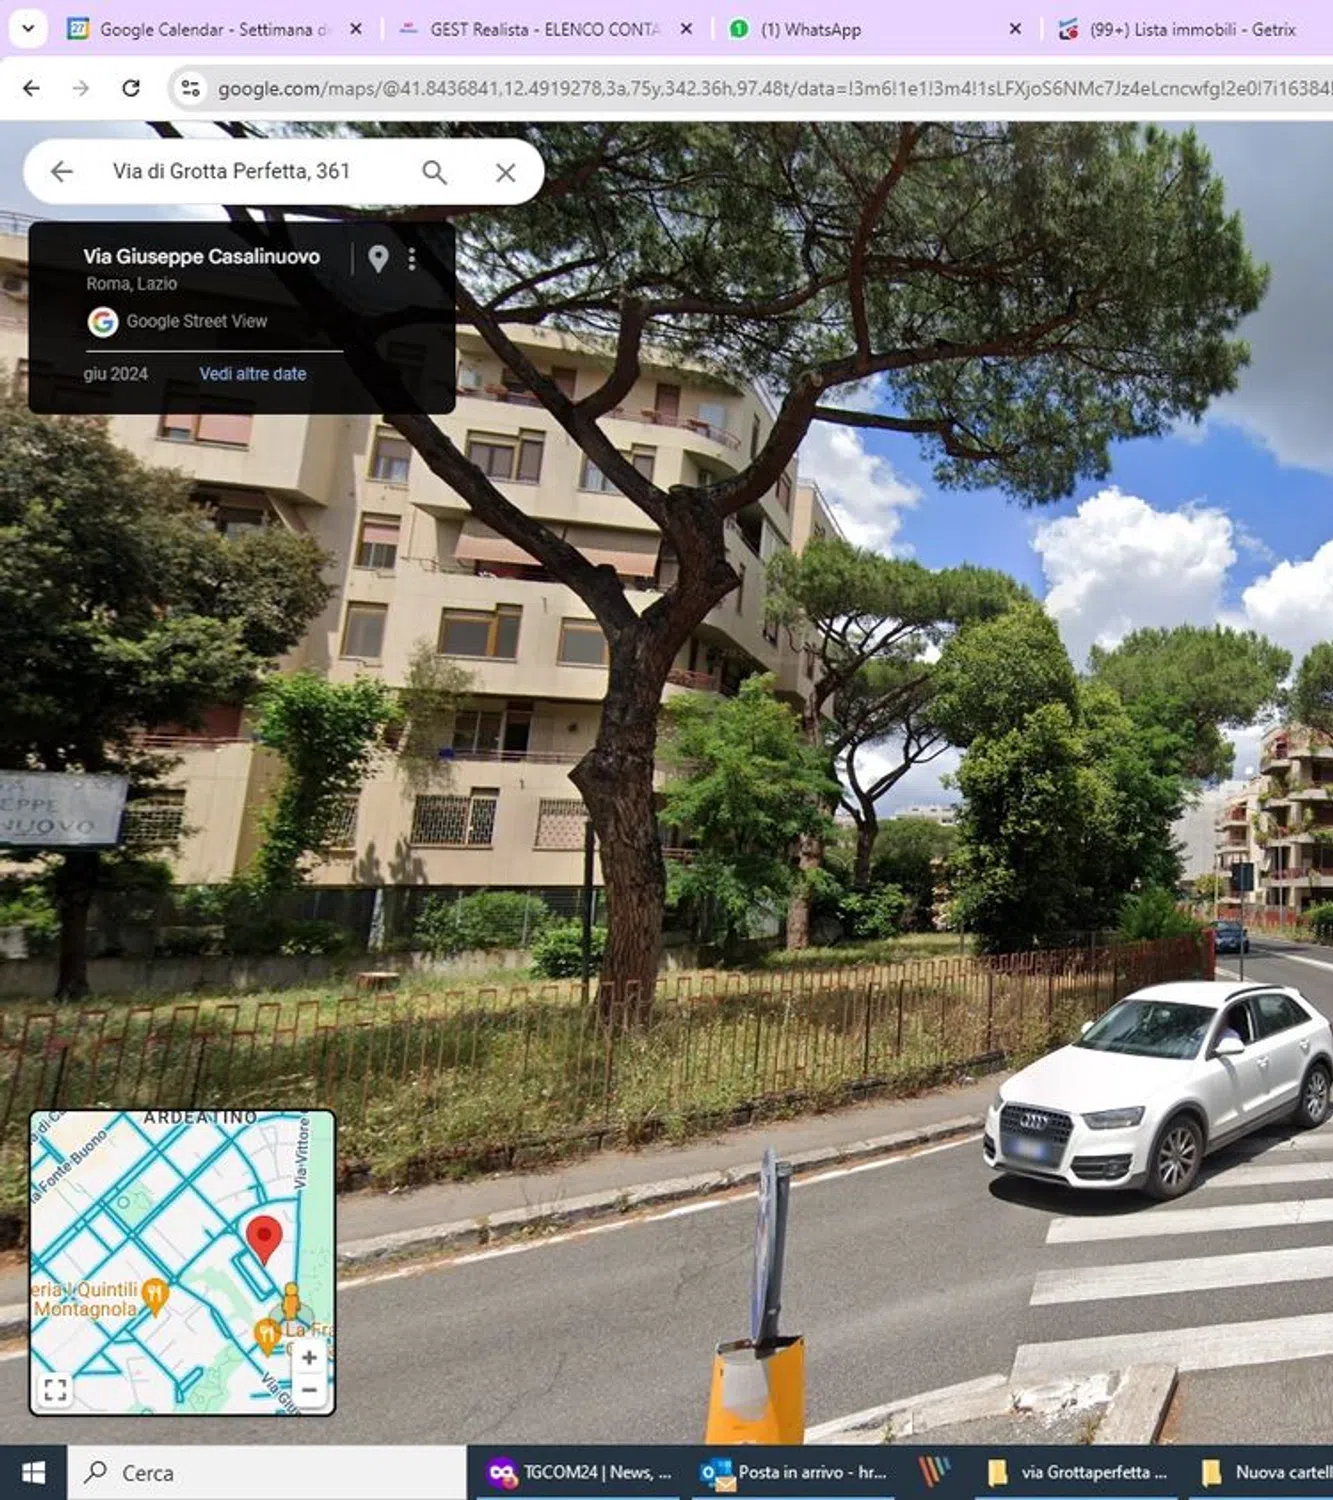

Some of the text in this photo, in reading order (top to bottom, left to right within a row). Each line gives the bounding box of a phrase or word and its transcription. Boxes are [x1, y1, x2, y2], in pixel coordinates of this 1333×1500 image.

[101, 22, 154, 40] Google
[159, 22, 224, 36] Calendar
[240, 22, 312, 36] Settimana
[431, 22, 468, 36] GEST
[474, 22, 528, 36] Realista
[546, 22, 604, 36] ELENCO
[762, 22, 861, 40] (1) WhatsApp
[1091, 22, 1129, 40] (99+)
[1136, 22, 1167, 36] Lista
[1172, 22, 1236, 36] immobili
[1252, 22, 1296, 36] Getrix
[113, 161, 349, 183] Via di Grotta Perfetta, 361
[83, 247, 321, 268] Via Giuseppe Casalinuovo
[87, 276, 178, 292] Roma, Lazio
[127, 314, 267, 331] Google Street View
[84, 366, 148, 383] giu 2024
[199, 366, 306, 381] Vedi altre date
[143, 1111, 257, 1124] ARDEATINO
[38, 1161, 72, 1192] Fonte
[69, 1130, 107, 1165] Buono
[294, 1118, 311, 1189] Via Vittore
[79, 1281, 138, 1298] Quintili
[34, 1300, 136, 1319] Montagnola
[286, 1321, 305, 1337] La
[261, 1371, 279, 1394] Via
[123, 1465, 174, 1482] Cerca
[524, 1464, 598, 1480] TGCOM24
[611, 1464, 654, 1482] News,
[740, 1464, 780, 1480] Posta
[784, 1464, 798, 1479] in
[802, 1464, 844, 1480] arrivo
[859, 1465, 887, 1479] hr...
[1022, 1464, 1044, 1480] via
[1048, 1464, 1150, 1483] Grottaperfetta
[1237, 1464, 1285, 1480] Nuova
